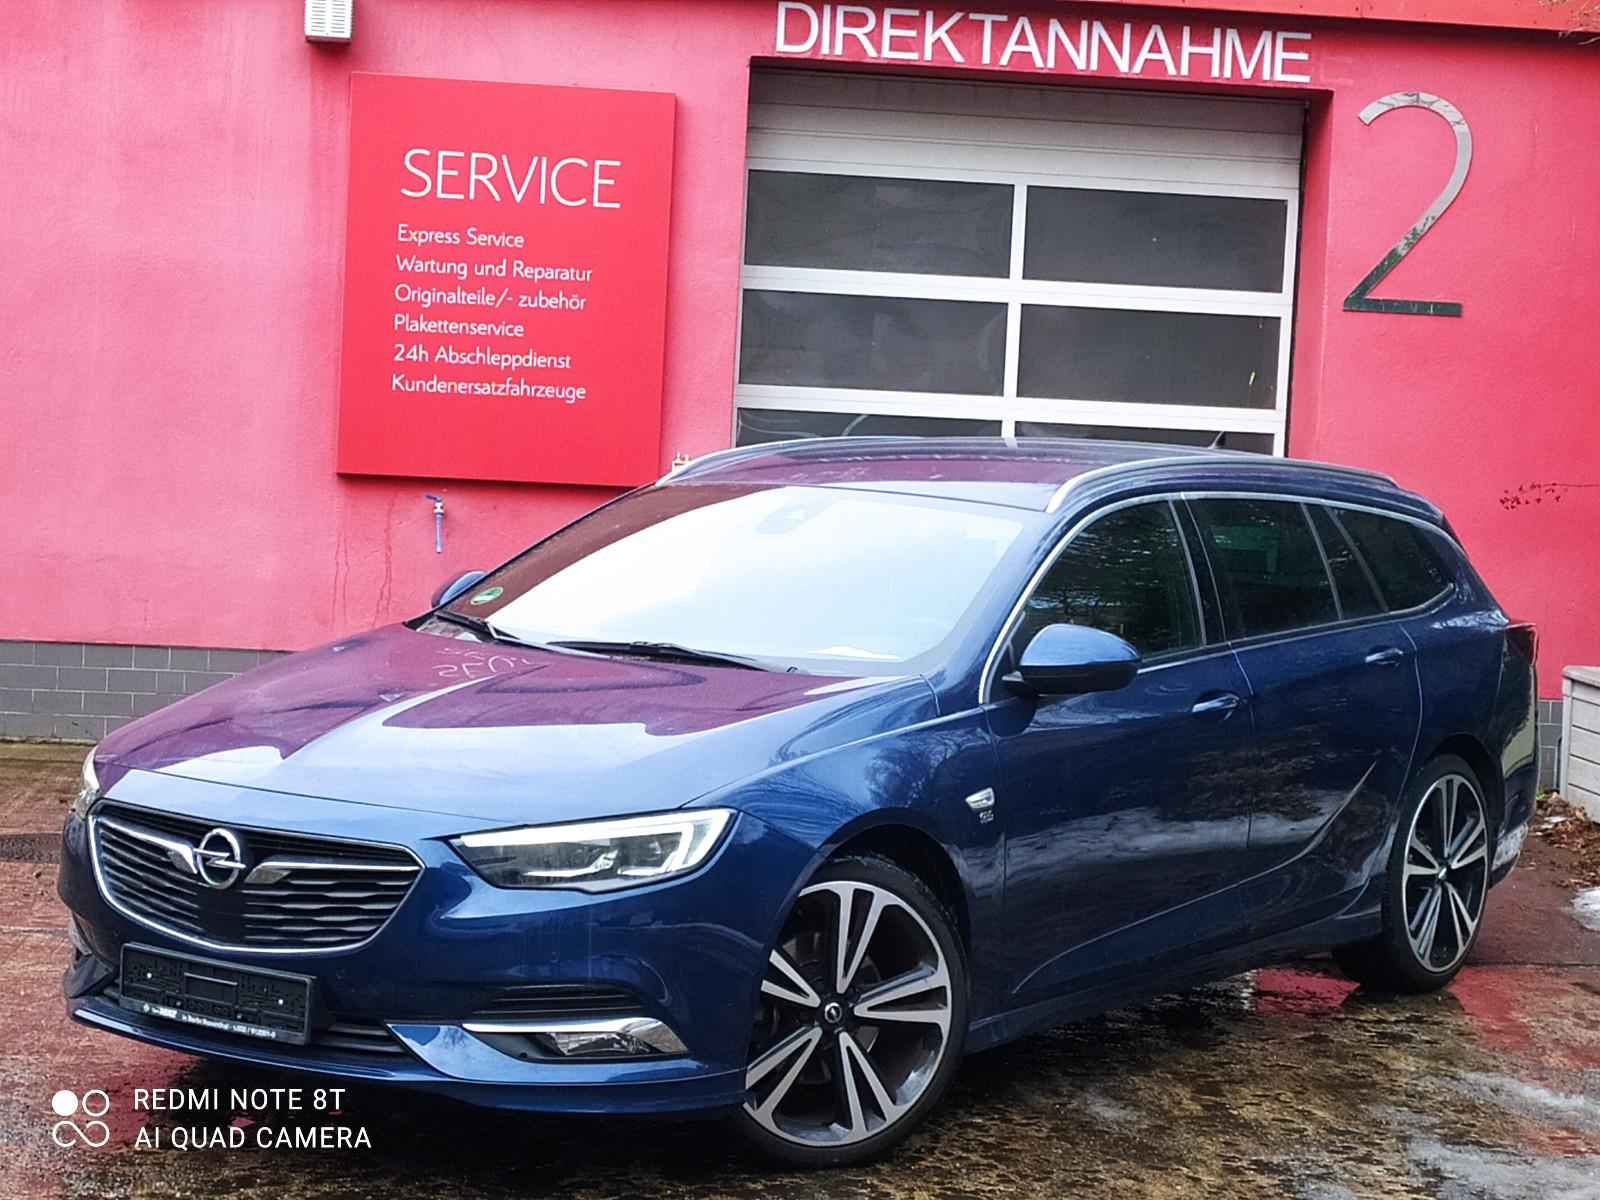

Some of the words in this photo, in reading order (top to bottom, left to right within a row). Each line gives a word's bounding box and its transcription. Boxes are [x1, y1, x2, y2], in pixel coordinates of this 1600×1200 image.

[774, 1, 1312, 83] DIREKTANNAHME
[400, 149, 622, 209] SERVICE
[1342, 91, 1473, 318] 2
[398, 224, 461, 247] Express
[467, 228, 525, 249] Service
[396, 254, 468, 280] Wartung
[475, 259, 507, 277] und
[513, 260, 593, 284] Reparatur
[518, 291, 586, 310] zubehör
[395, 313, 525, 337] Plakettenservice
[395, 344, 429, 362] 24h
[435, 345, 571, 371] Abschleppdienst
[392, 374, 587, 404] Kundenersatzfahrzeuge
